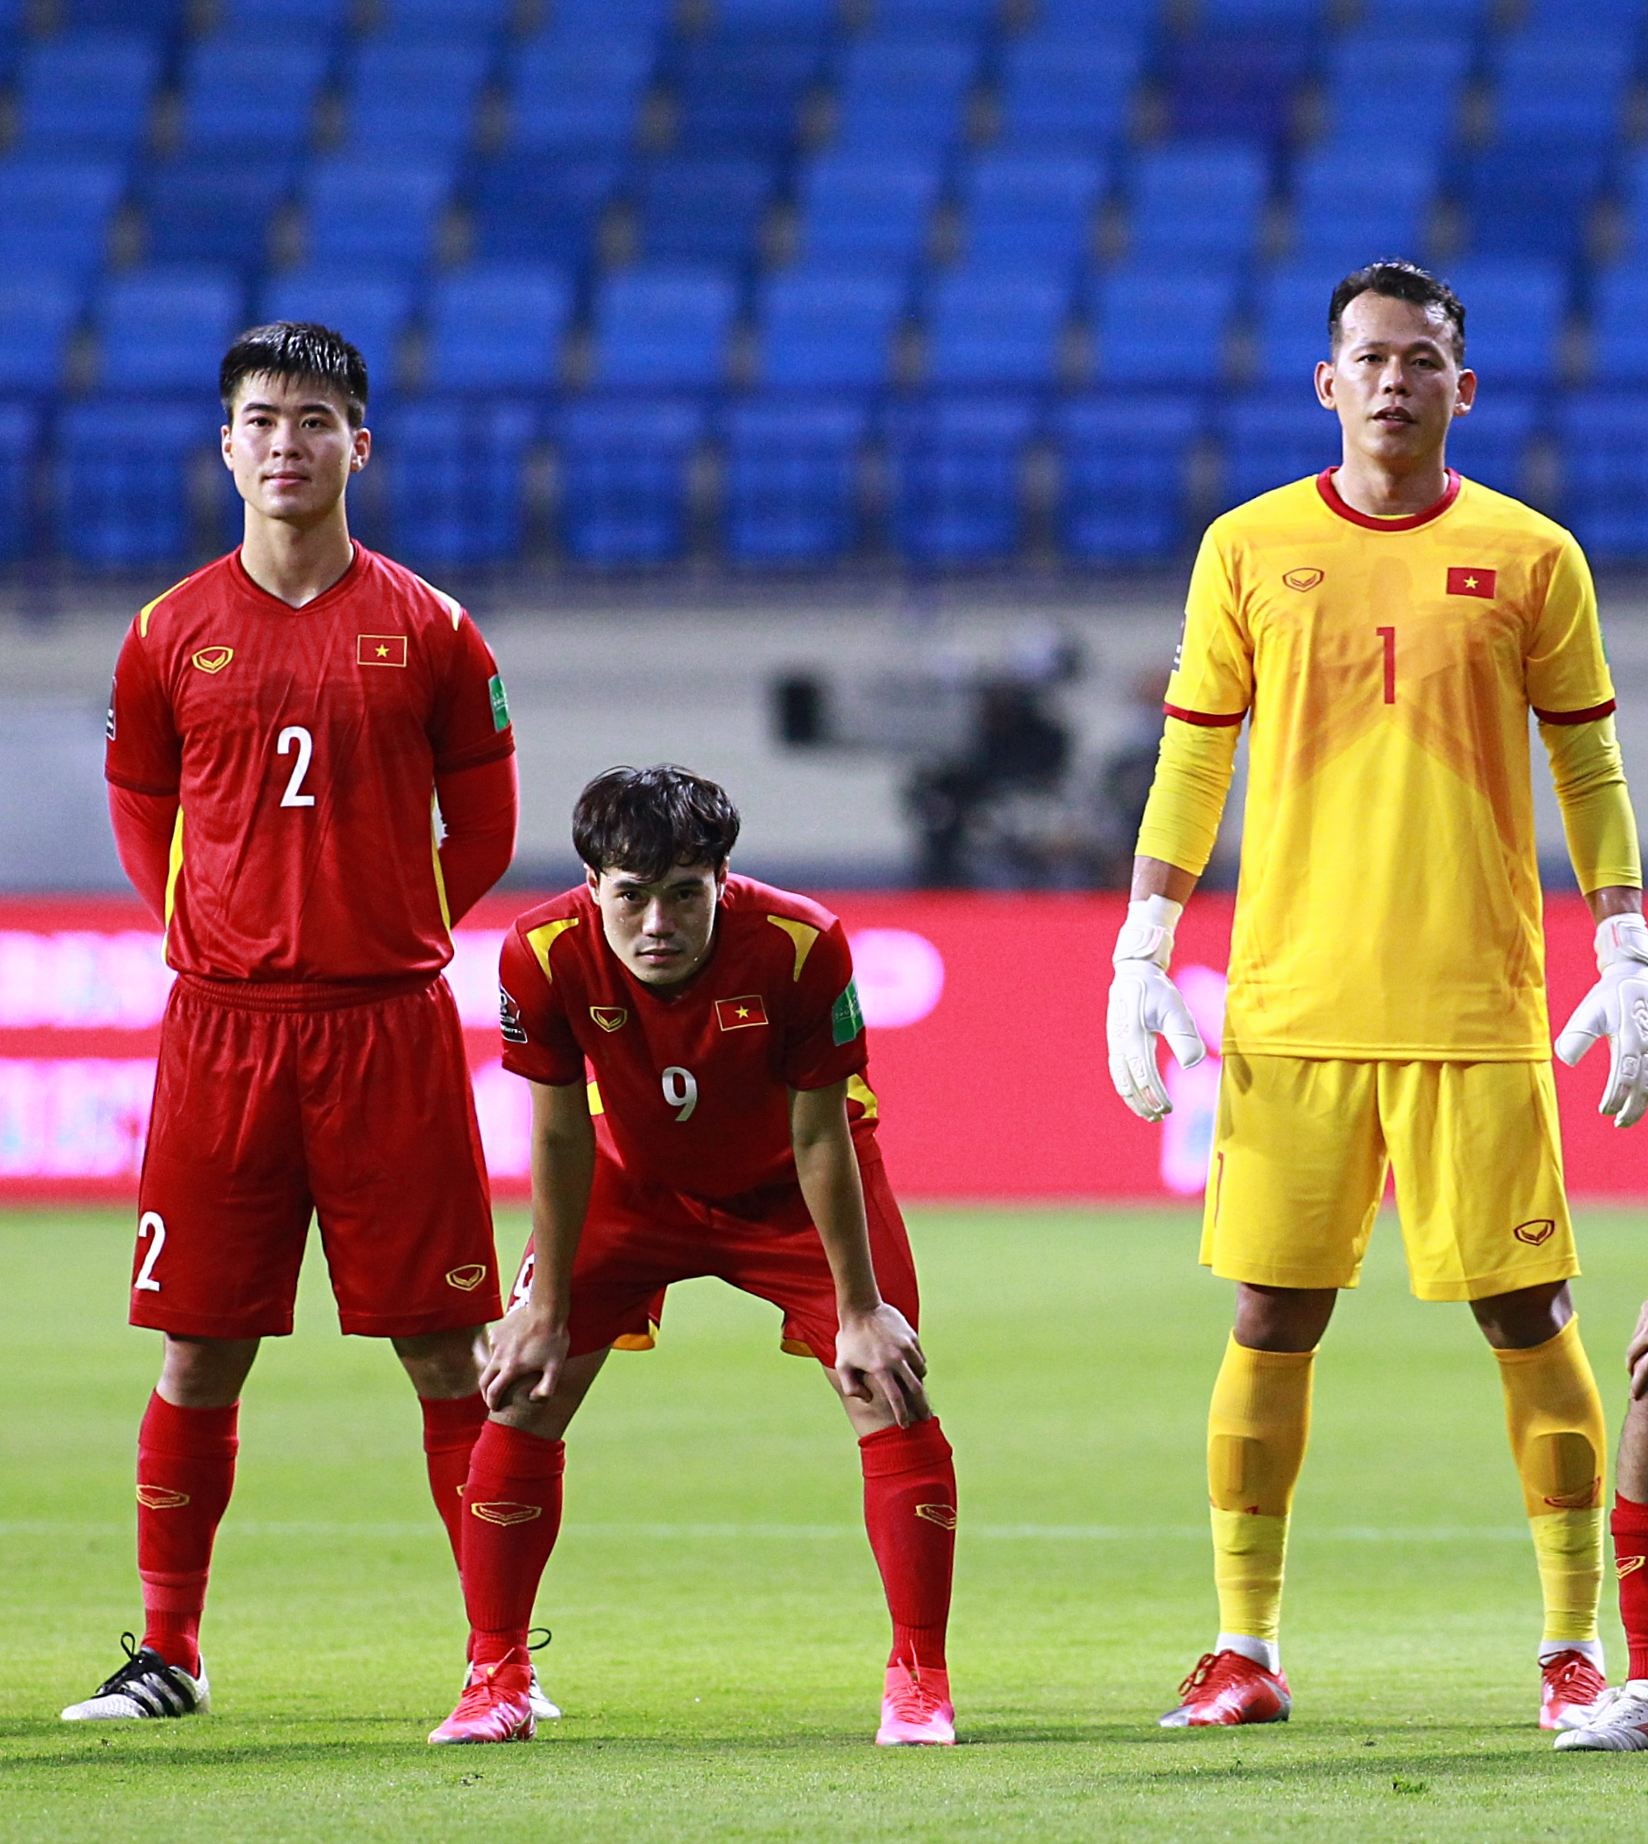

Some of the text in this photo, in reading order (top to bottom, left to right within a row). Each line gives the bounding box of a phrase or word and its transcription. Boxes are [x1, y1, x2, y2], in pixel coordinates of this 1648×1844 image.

[1376, 626, 1396, 705] 1
[277, 726, 315, 807] 2
[662, 1066, 698, 1122] 9
[134, 1210, 166, 1293] 2
